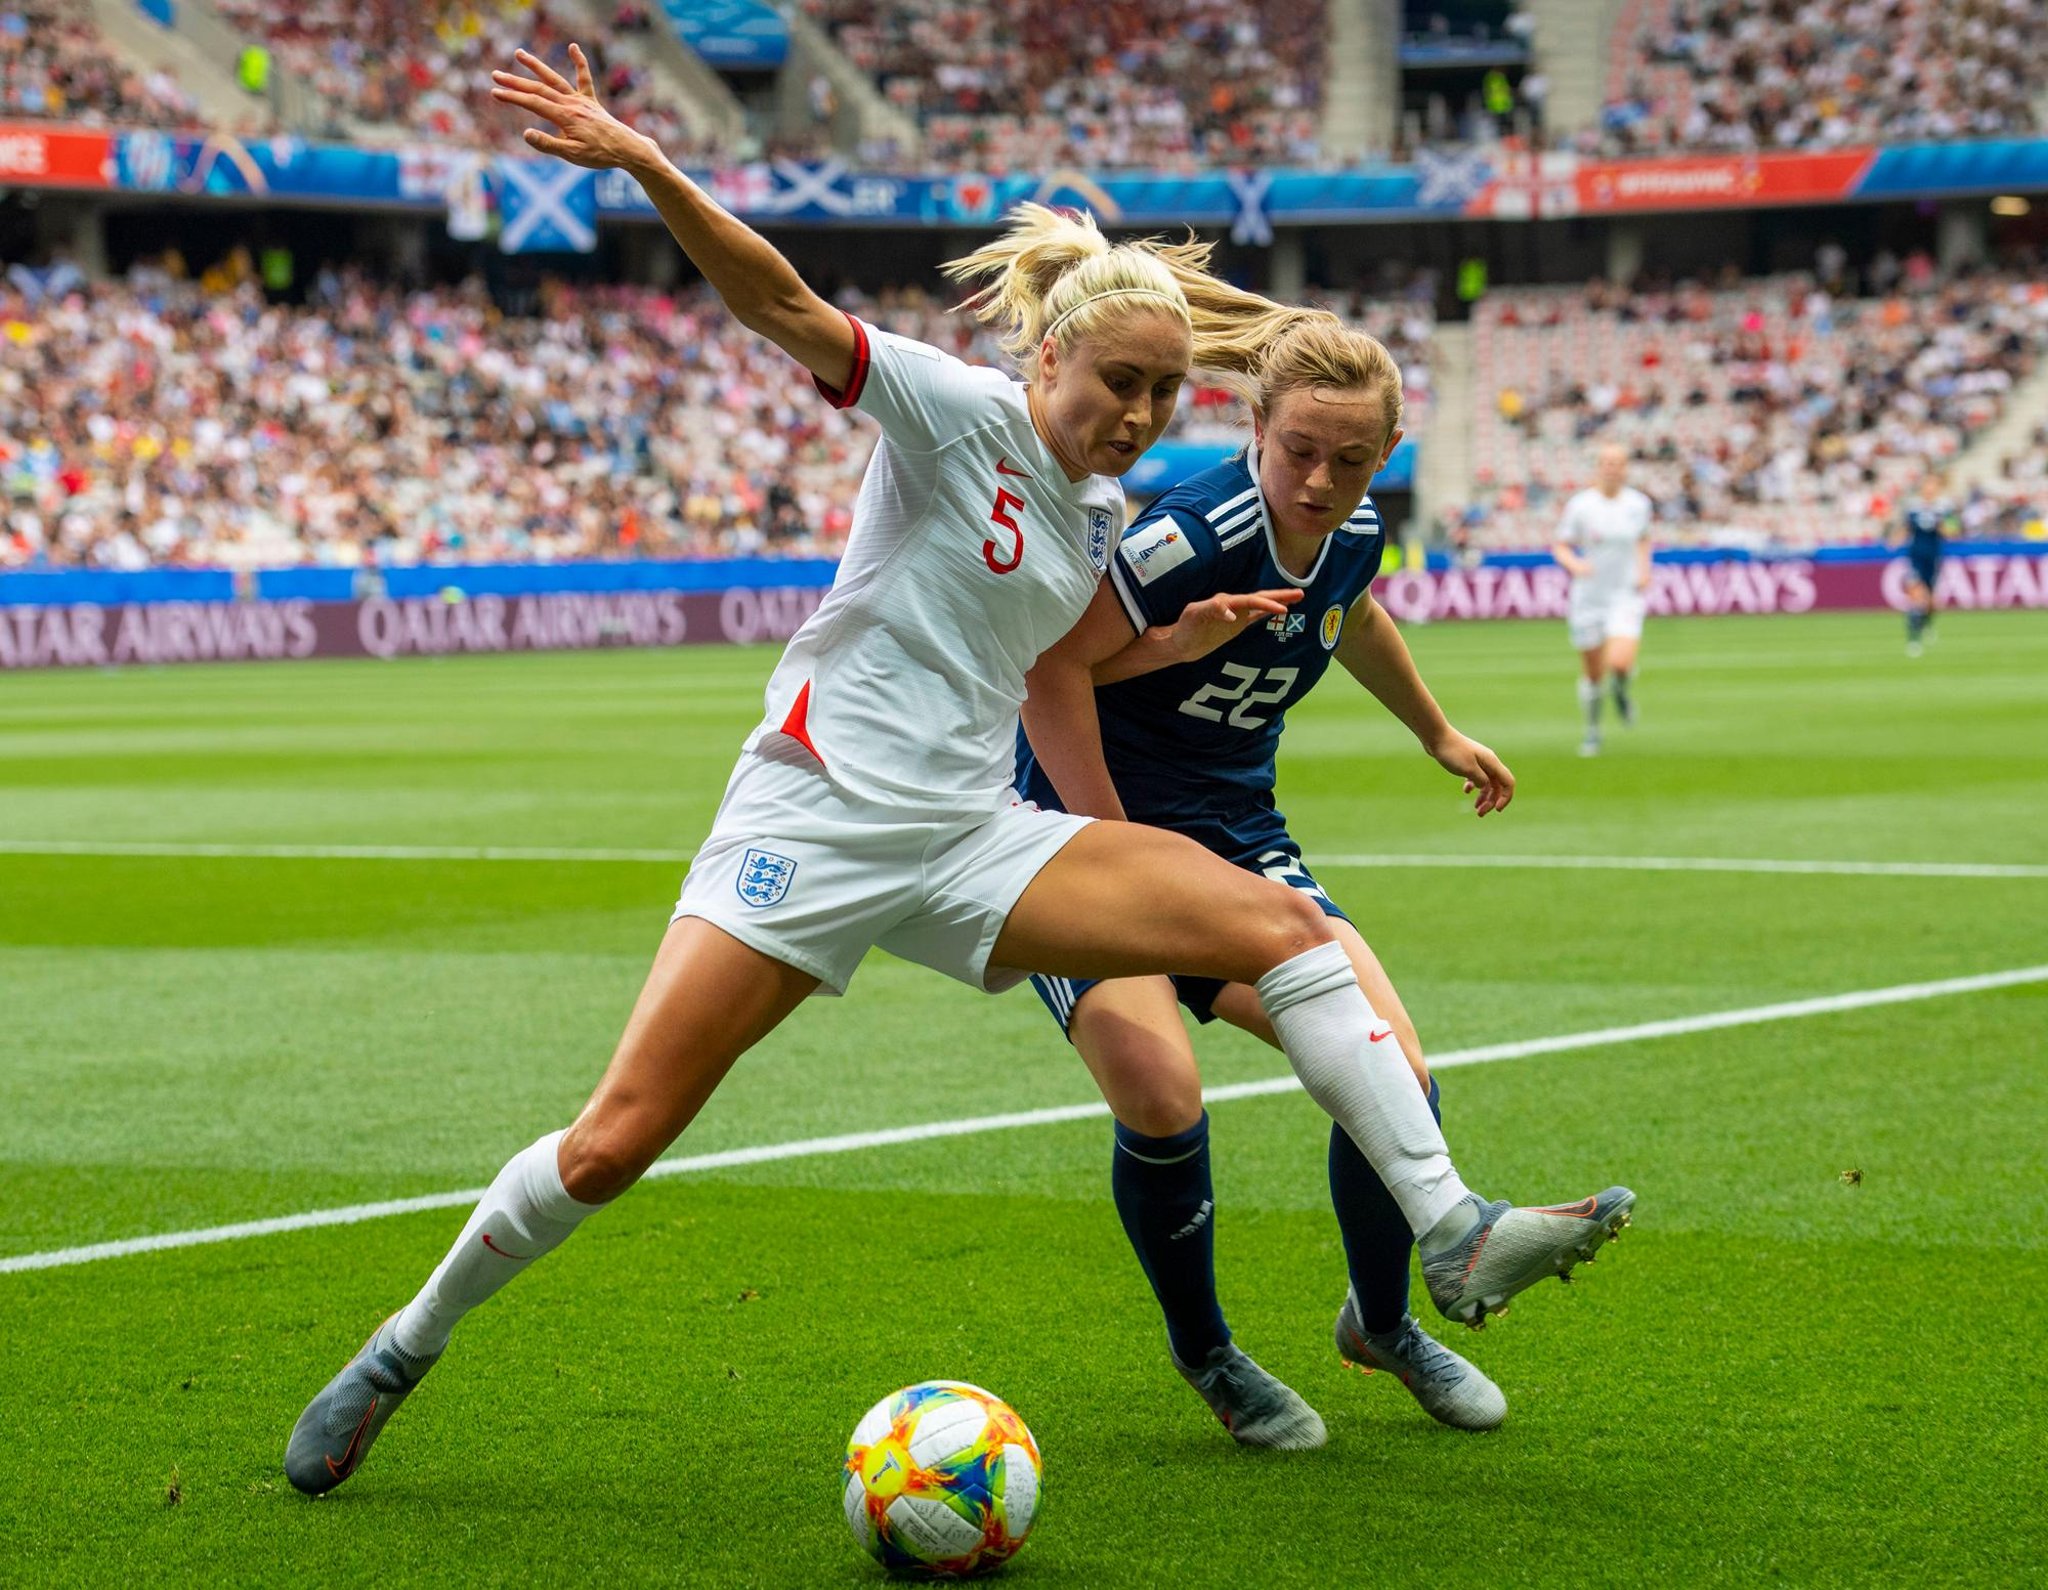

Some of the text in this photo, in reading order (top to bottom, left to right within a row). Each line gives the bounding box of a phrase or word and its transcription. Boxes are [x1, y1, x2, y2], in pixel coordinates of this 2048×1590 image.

[983, 487, 1025, 574] 5
[1385, 565, 1570, 621] QATAR
[1881, 555, 2048, 611] QATA
[114, 598, 316, 662] AIRWAYS
[358, 589, 686, 658] QATAR AIRWAYS
[1178, 661, 1300, 730] 22
